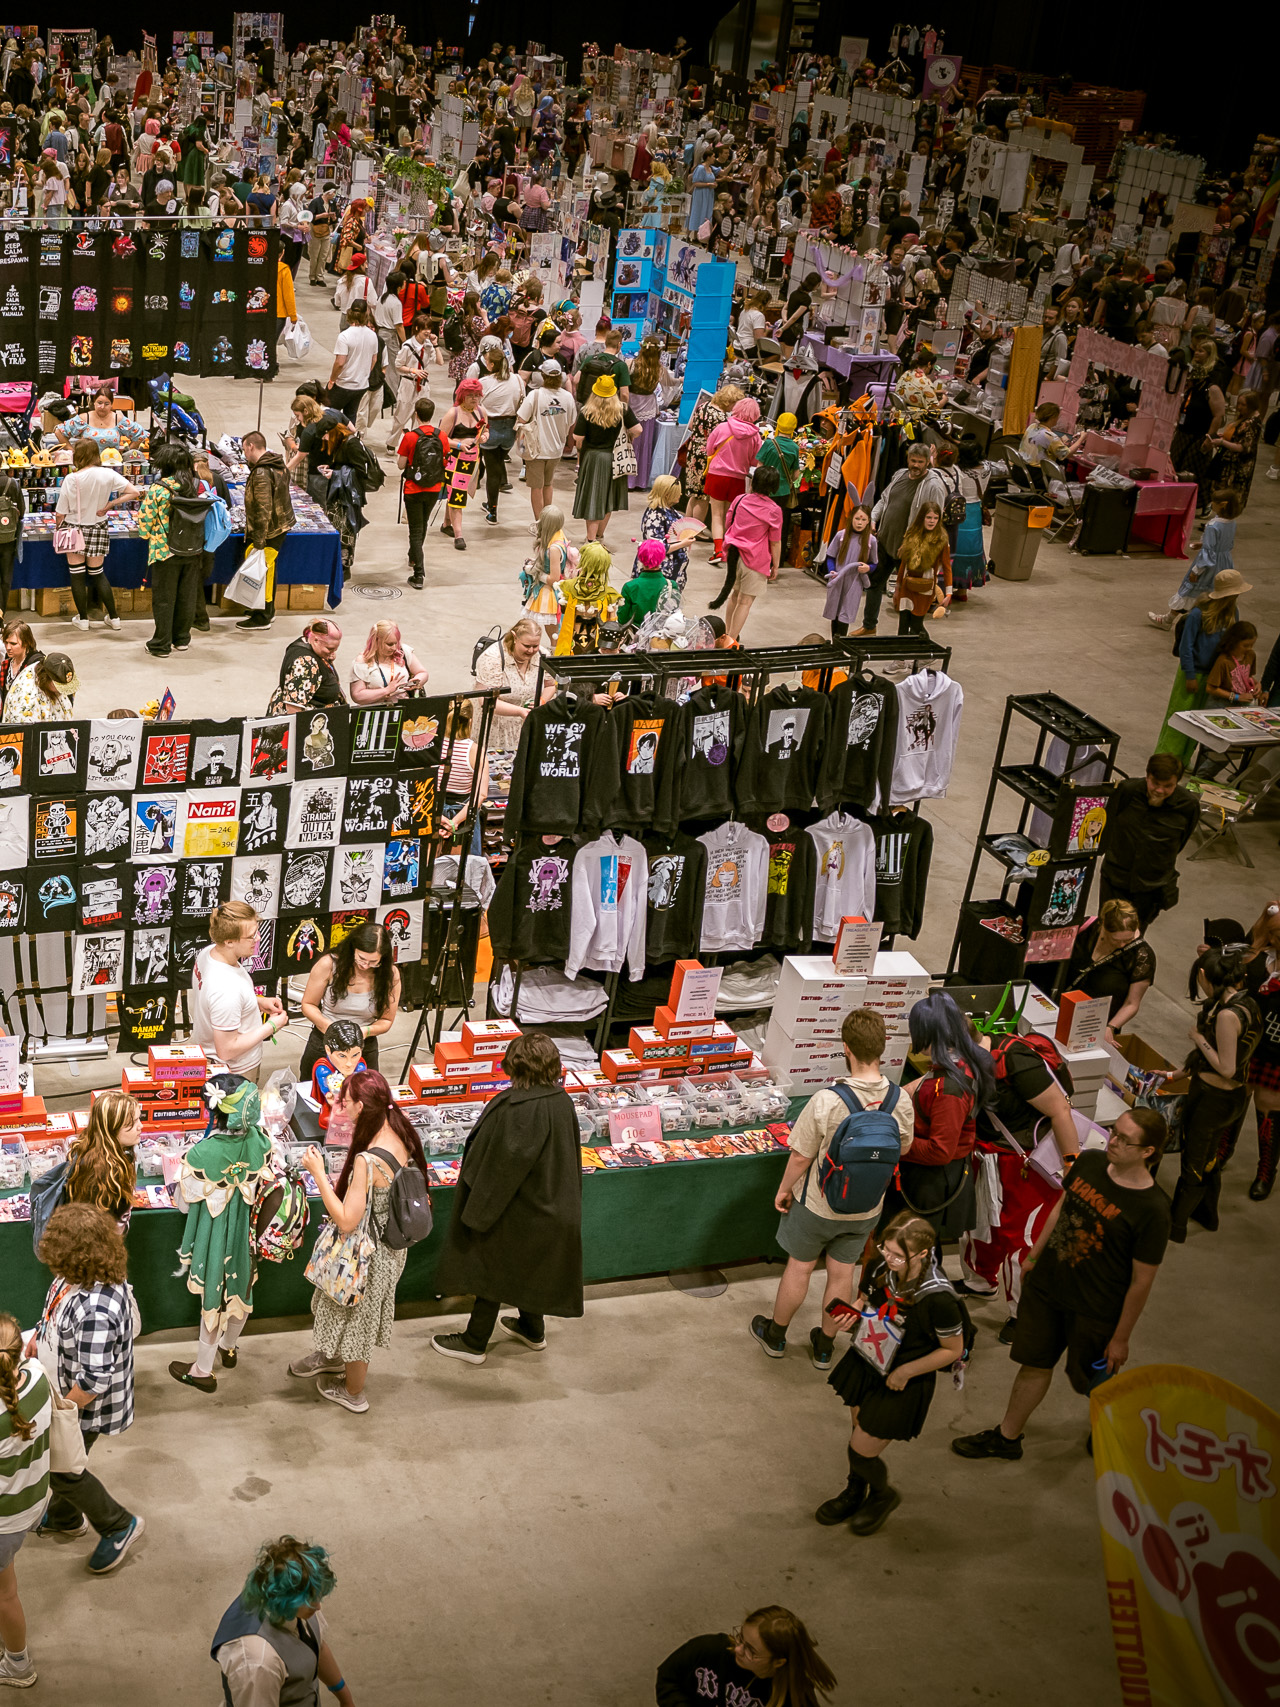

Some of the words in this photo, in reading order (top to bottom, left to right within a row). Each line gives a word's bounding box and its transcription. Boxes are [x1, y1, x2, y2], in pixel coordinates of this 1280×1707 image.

[570, 722, 586, 732] GO
[101, 734, 115, 742] YOU
[116, 734, 136, 742] EVEN
[540, 767, 580, 777] WORLD
[374, 778, 393, 788] GO
[245, 792, 261, 808] 五
[188, 802, 235, 817] Nani?
[301, 812, 336, 822] STRAIGHT
[218, 826, 232, 834] 24€
[303, 822, 332, 832] OUTTA
[345, 821, 388, 832] WORLD!
[300, 832, 332, 842] NAPLES
[1028, 852, 1049, 863] 24€
[84, 912, 122, 924] SENPAI
[1035, 929, 1074, 941] POSTER
[132, 1024, 164, 1034] BANANA
[138, 1031, 157, 1040] FISH
[614, 1111, 653, 1120] MOUSEPAD
[626, 1128, 646, 1138] 10€
